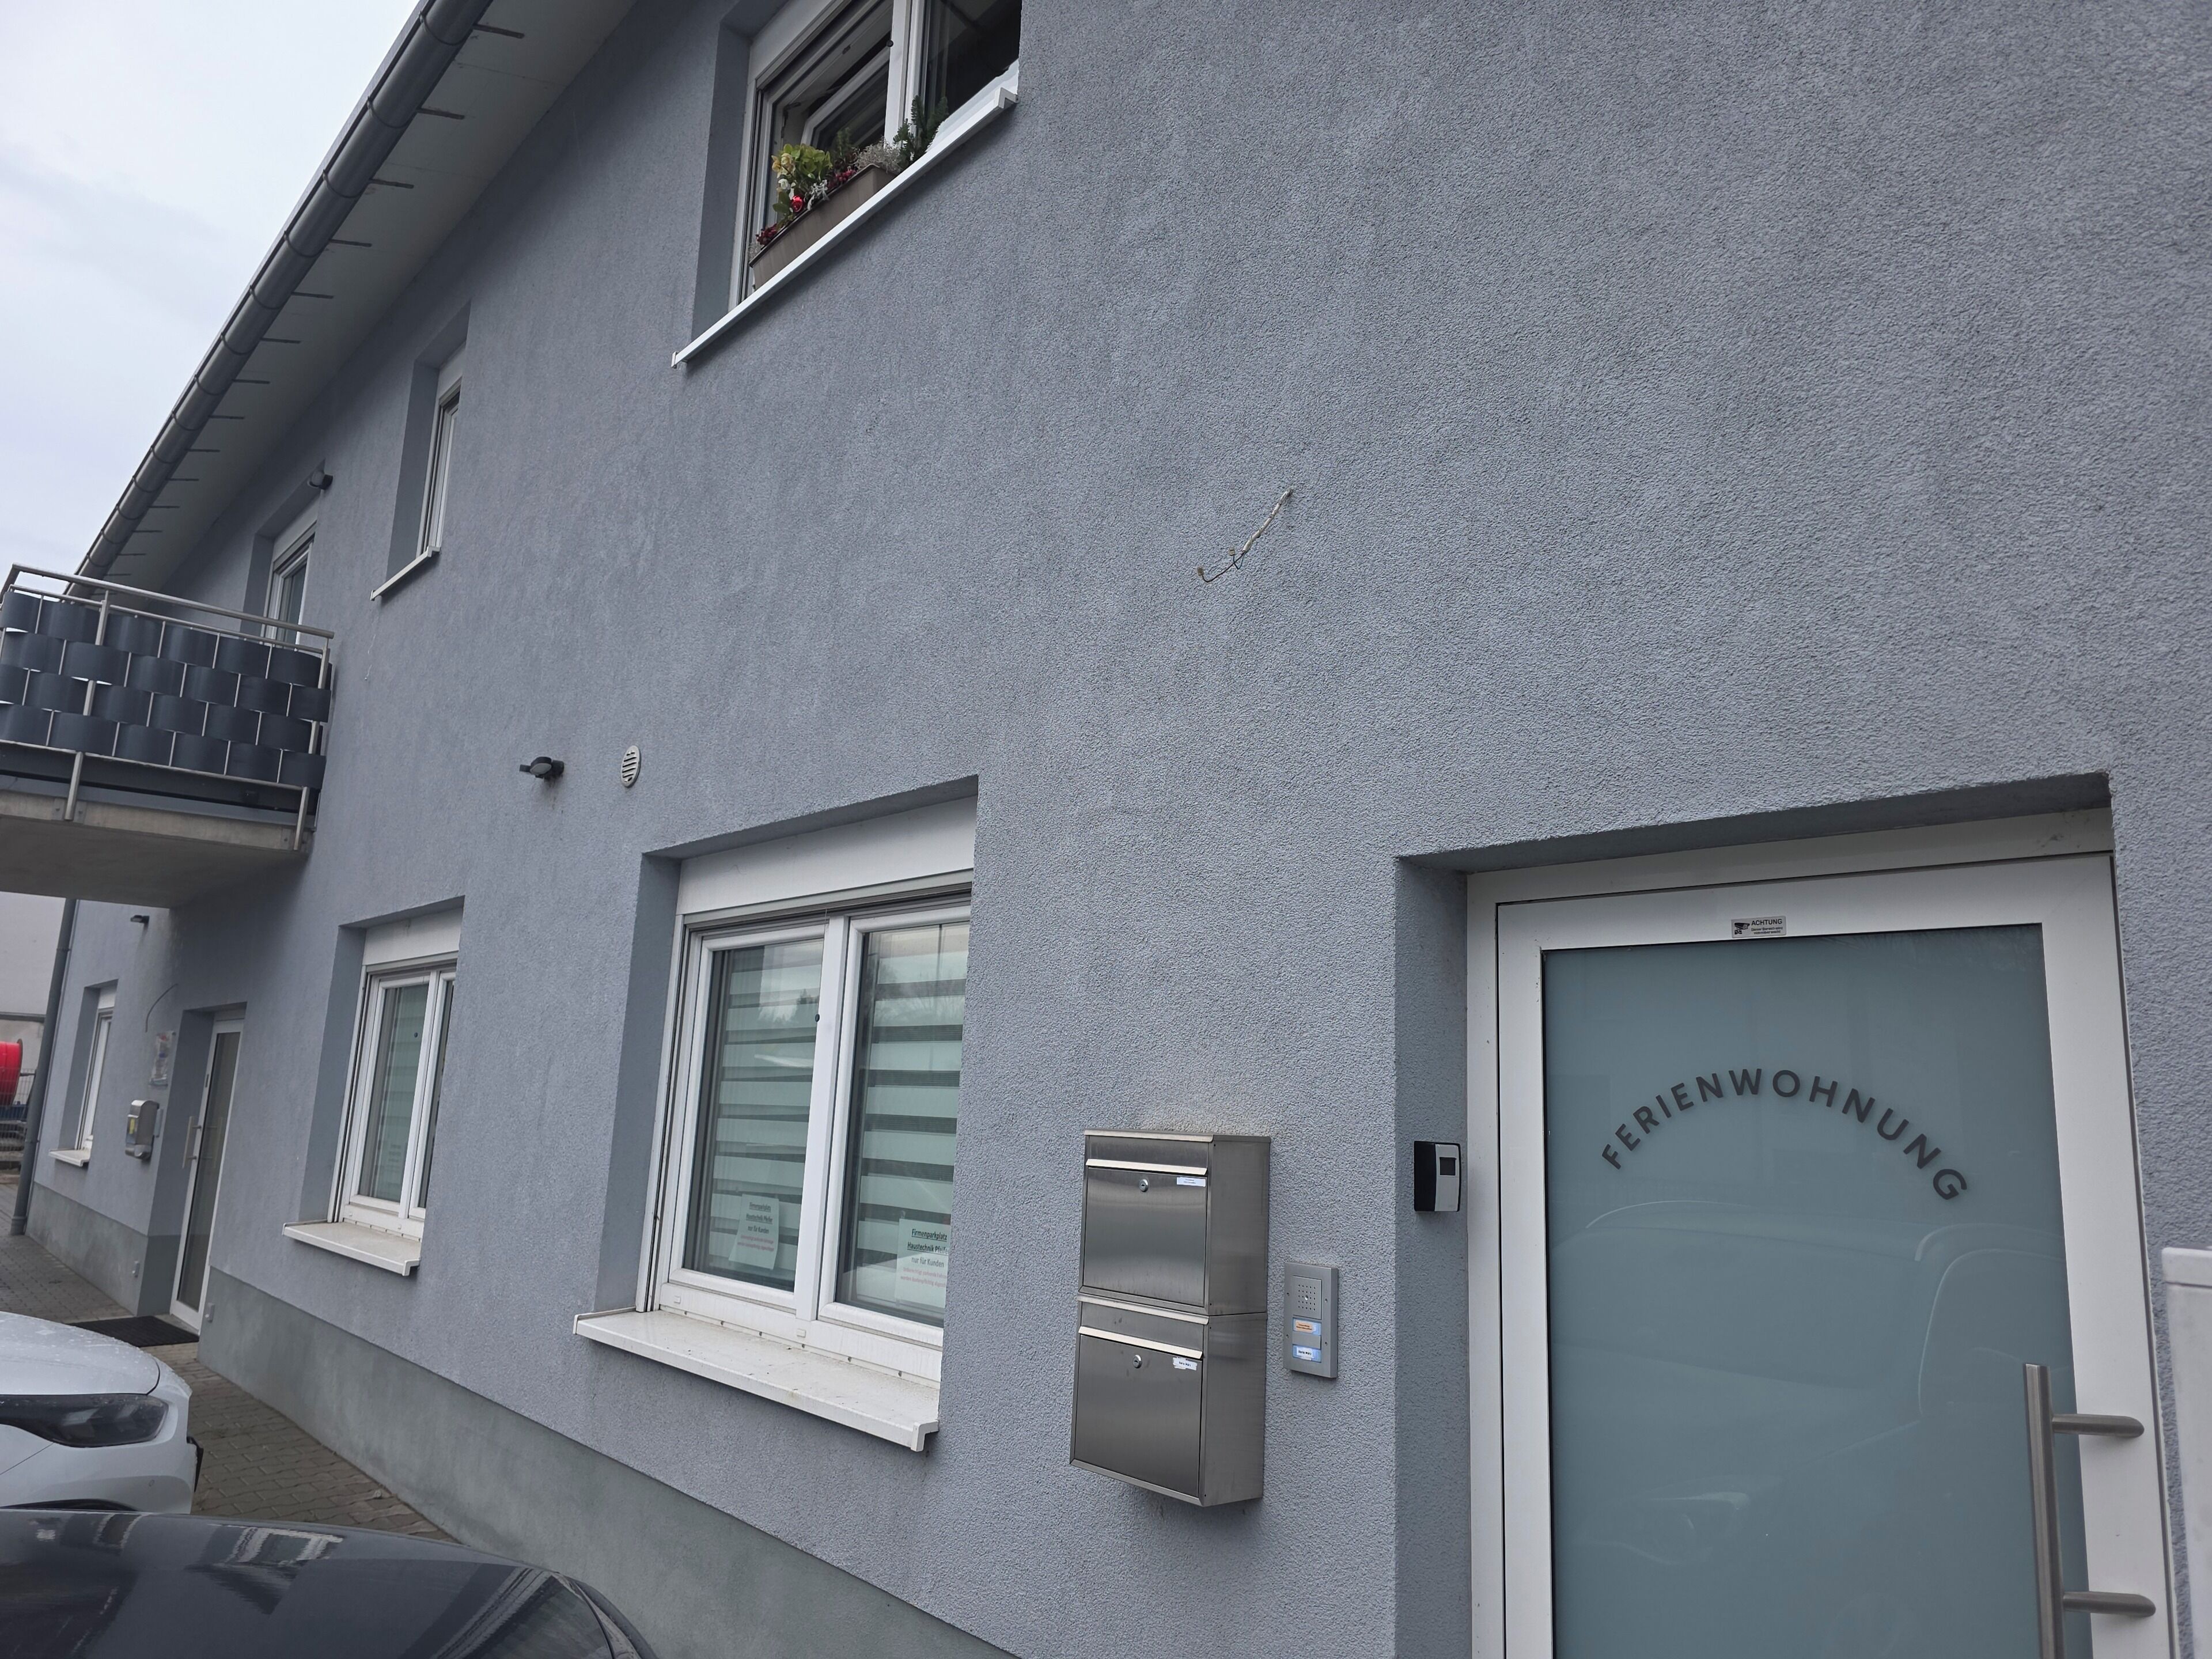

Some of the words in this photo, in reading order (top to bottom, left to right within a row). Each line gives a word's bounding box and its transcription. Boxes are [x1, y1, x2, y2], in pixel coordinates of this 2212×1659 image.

[1602, 1069, 1967, 1200] FERIENWOHNUNG
[912, 1229, 947, 1241] Firmenparkplatz
[907, 1242, 934, 1252] Haustechnik
[935, 1245, 949, 1255] Pfeife
[927, 1258, 944, 1268] Kunden
